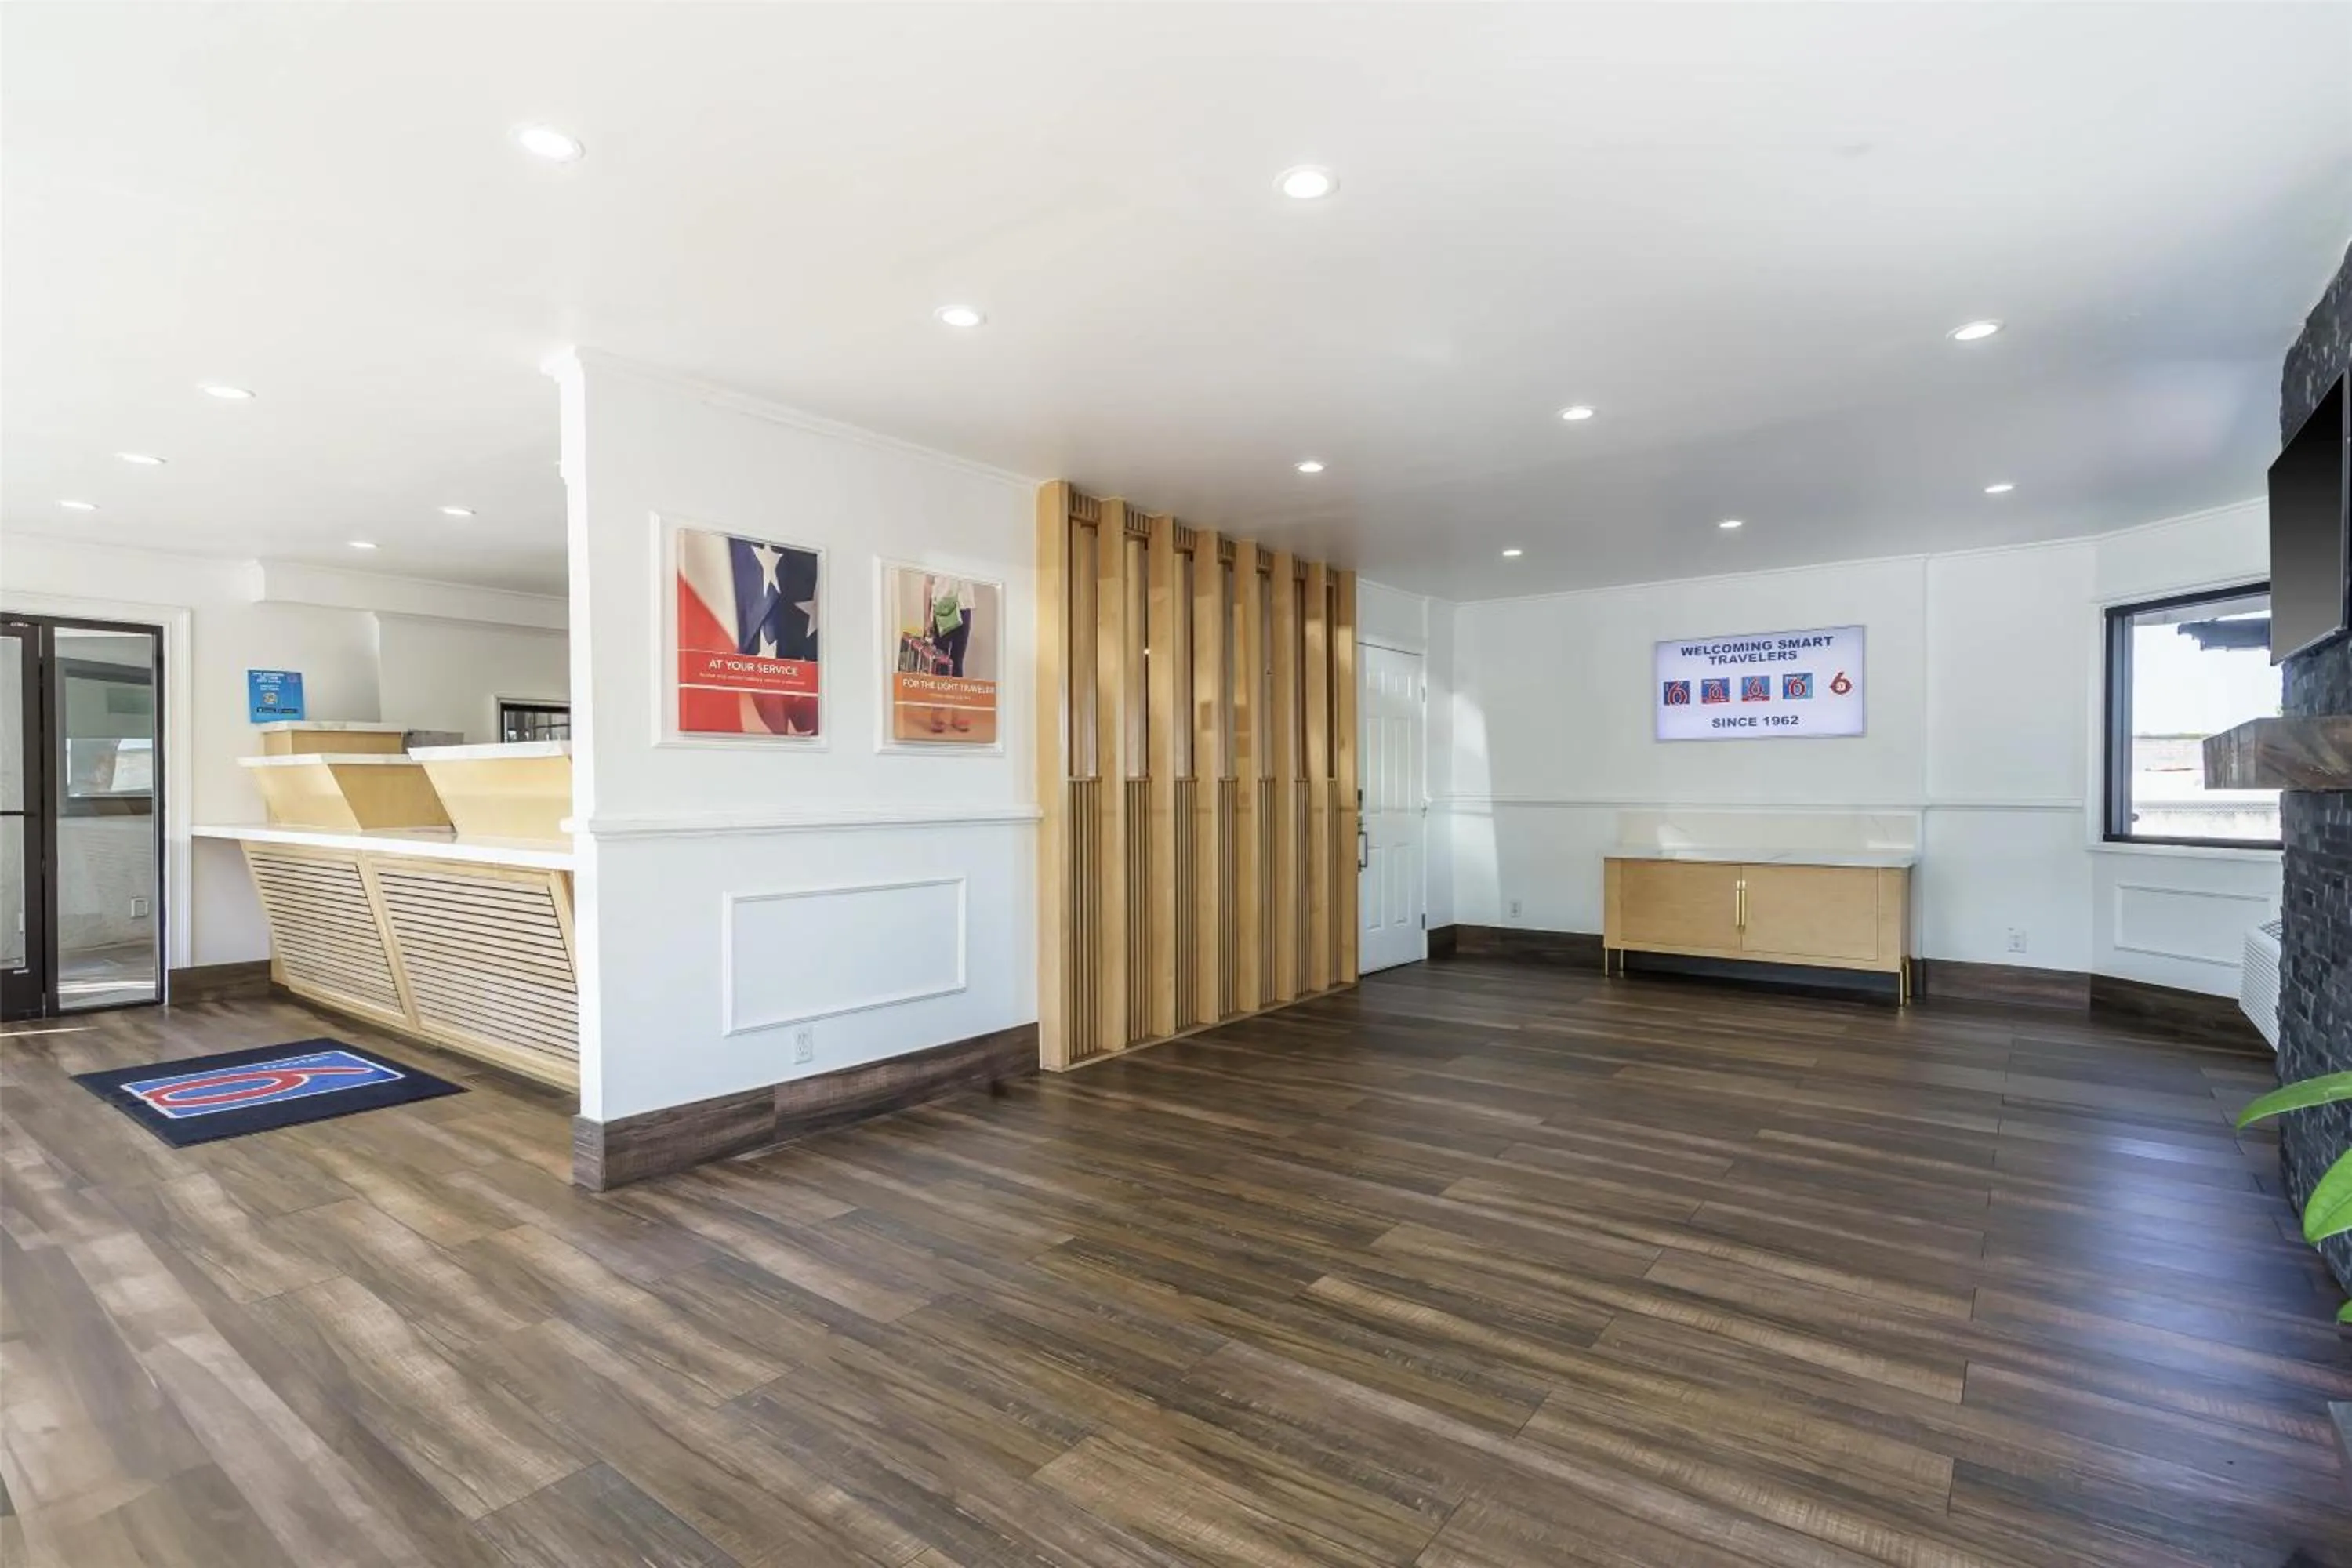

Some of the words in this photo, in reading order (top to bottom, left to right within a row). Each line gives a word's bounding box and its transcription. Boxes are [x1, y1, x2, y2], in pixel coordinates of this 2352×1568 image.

[1681, 641, 1773, 656] WELCOMING
[1777, 636, 1834, 649] SMART
[1708, 650, 1798, 666] TRAVELERS
[709, 659, 724, 670] AT
[726, 661, 755, 672] YOUR
[757, 663, 798, 676] SERVICE
[902, 678, 920, 688] FOR
[920, 680, 935, 689] THE
[937, 681, 959, 691] LIGHT
[1829, 671, 1853, 695] 6
[1711, 717, 1757, 728] SINCE
[1763, 715, 1799, 726] 1962
